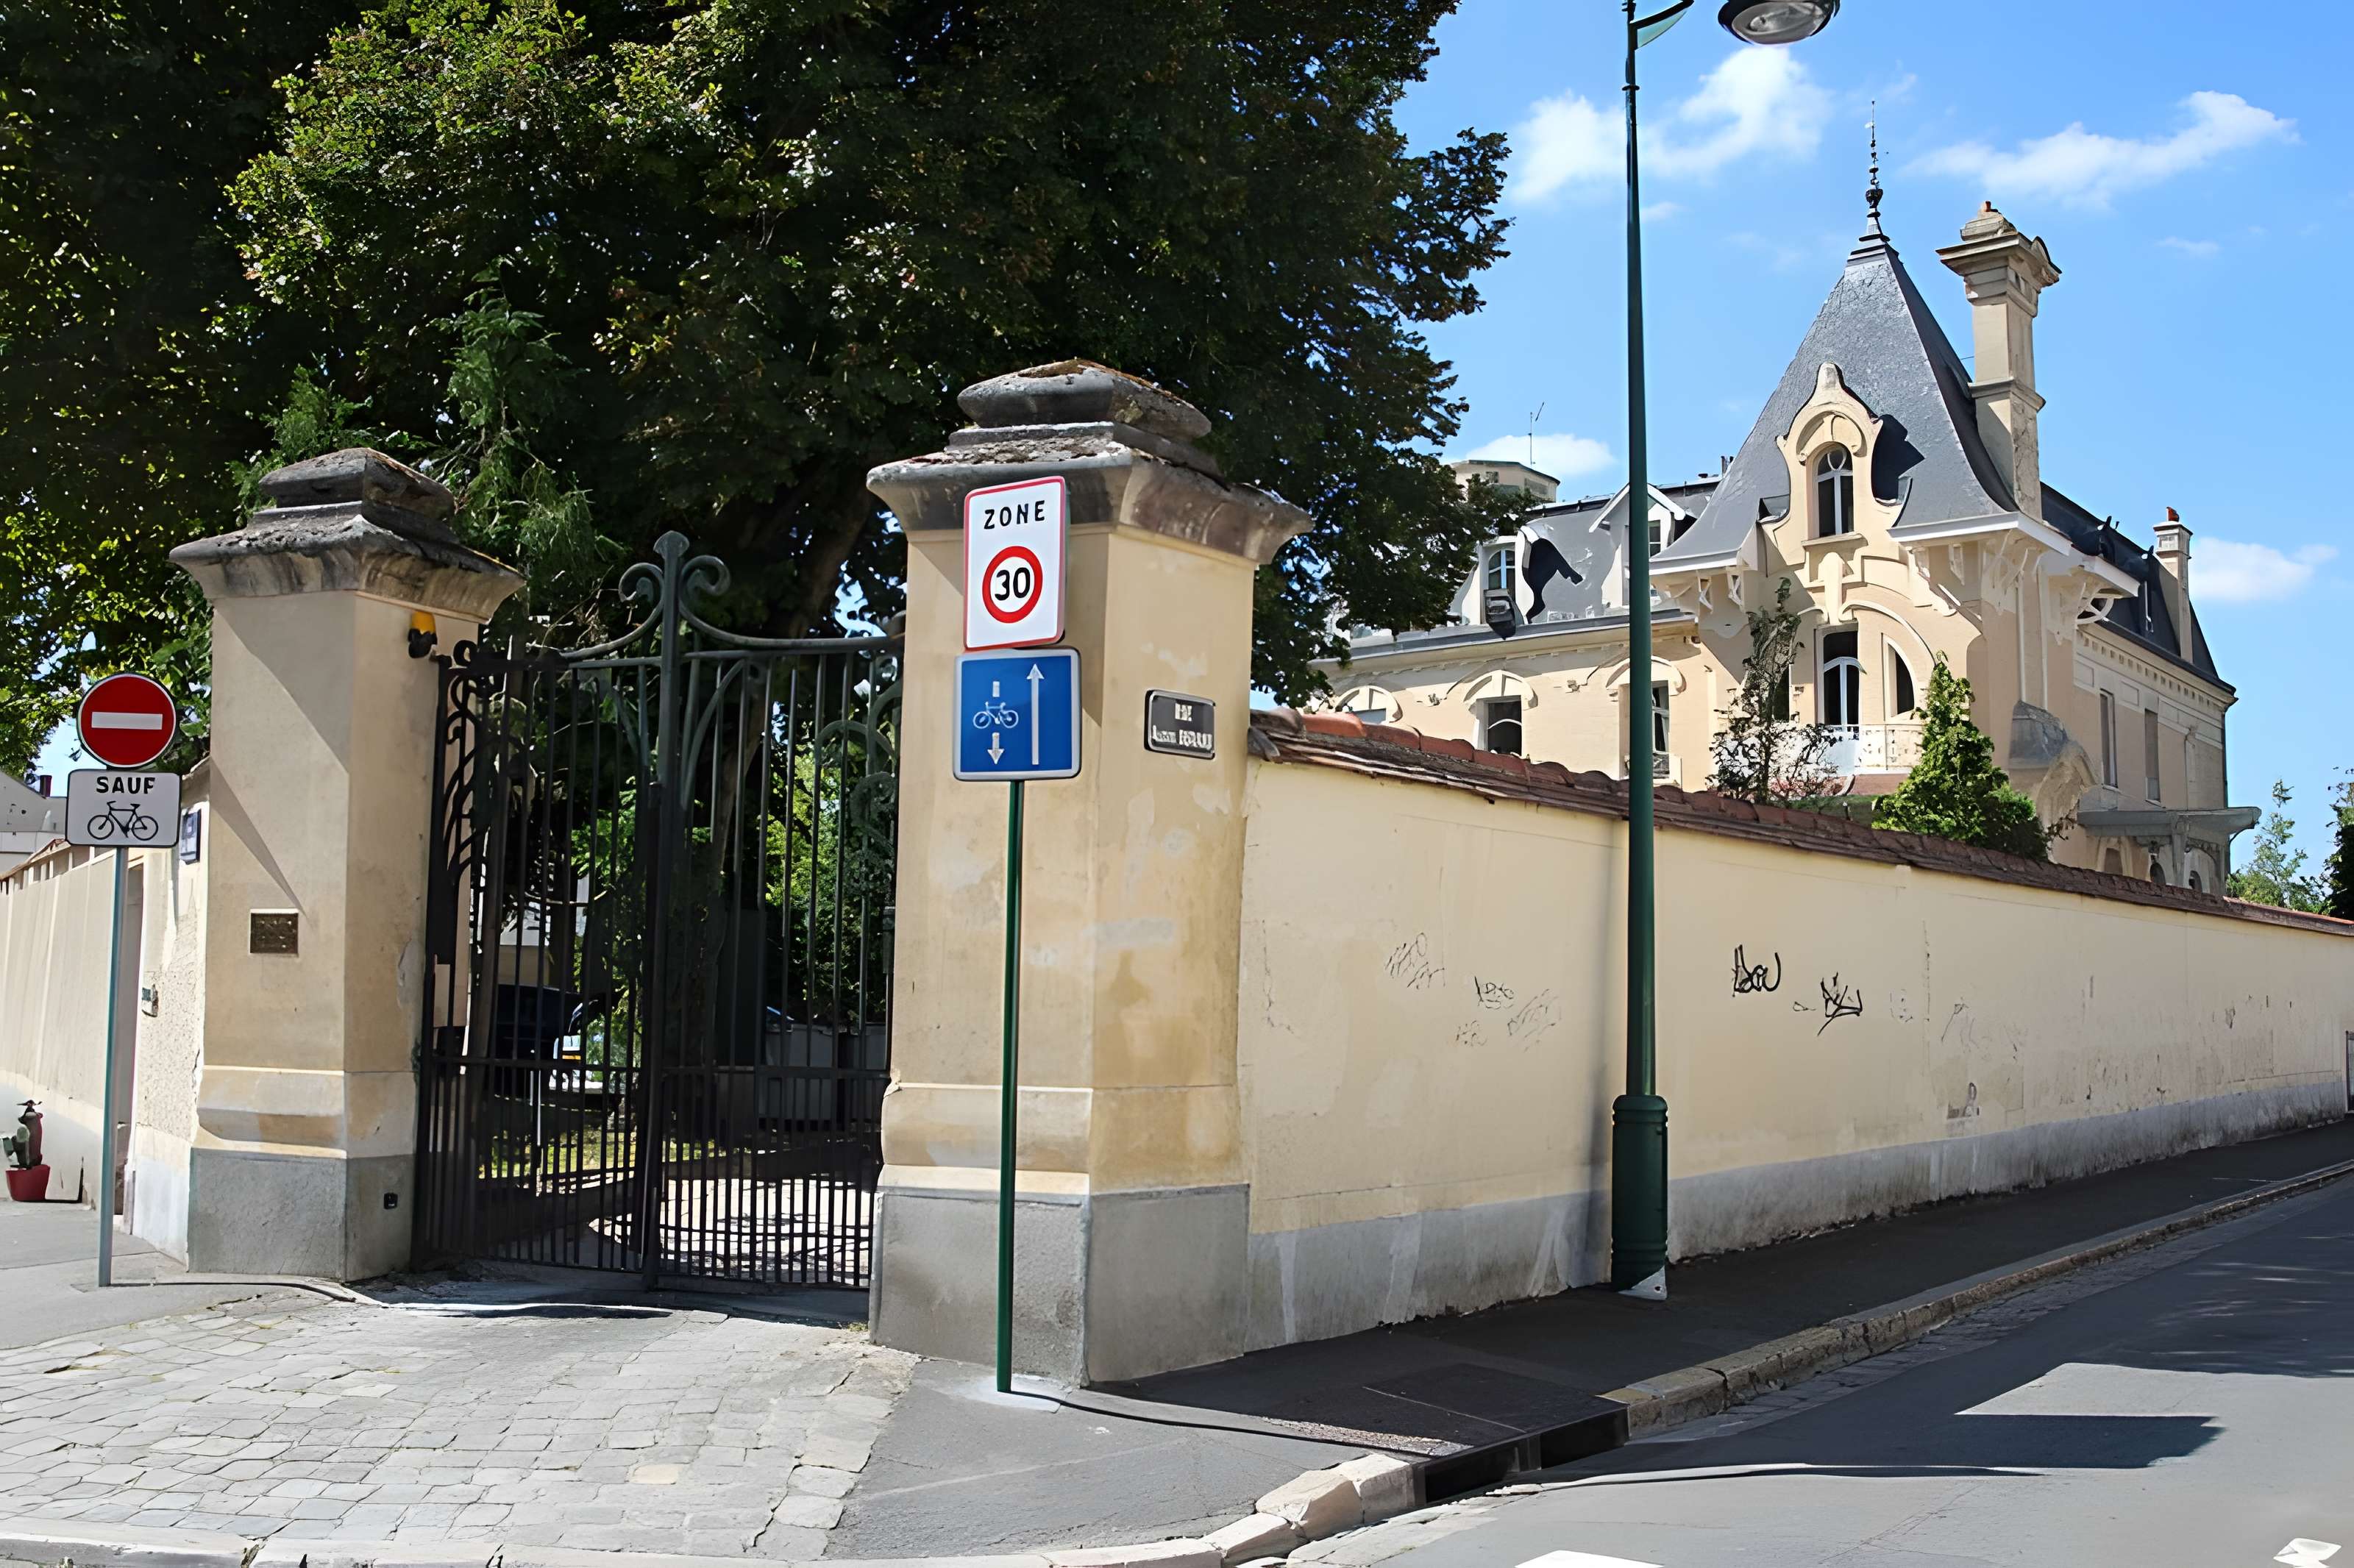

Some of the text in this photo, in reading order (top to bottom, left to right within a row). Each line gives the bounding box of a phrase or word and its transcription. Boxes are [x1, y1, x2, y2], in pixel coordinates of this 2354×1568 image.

[984, 500, 1045, 530] ZONE
[995, 567, 1031, 601] 30
[96, 776, 156, 795] SAUF
